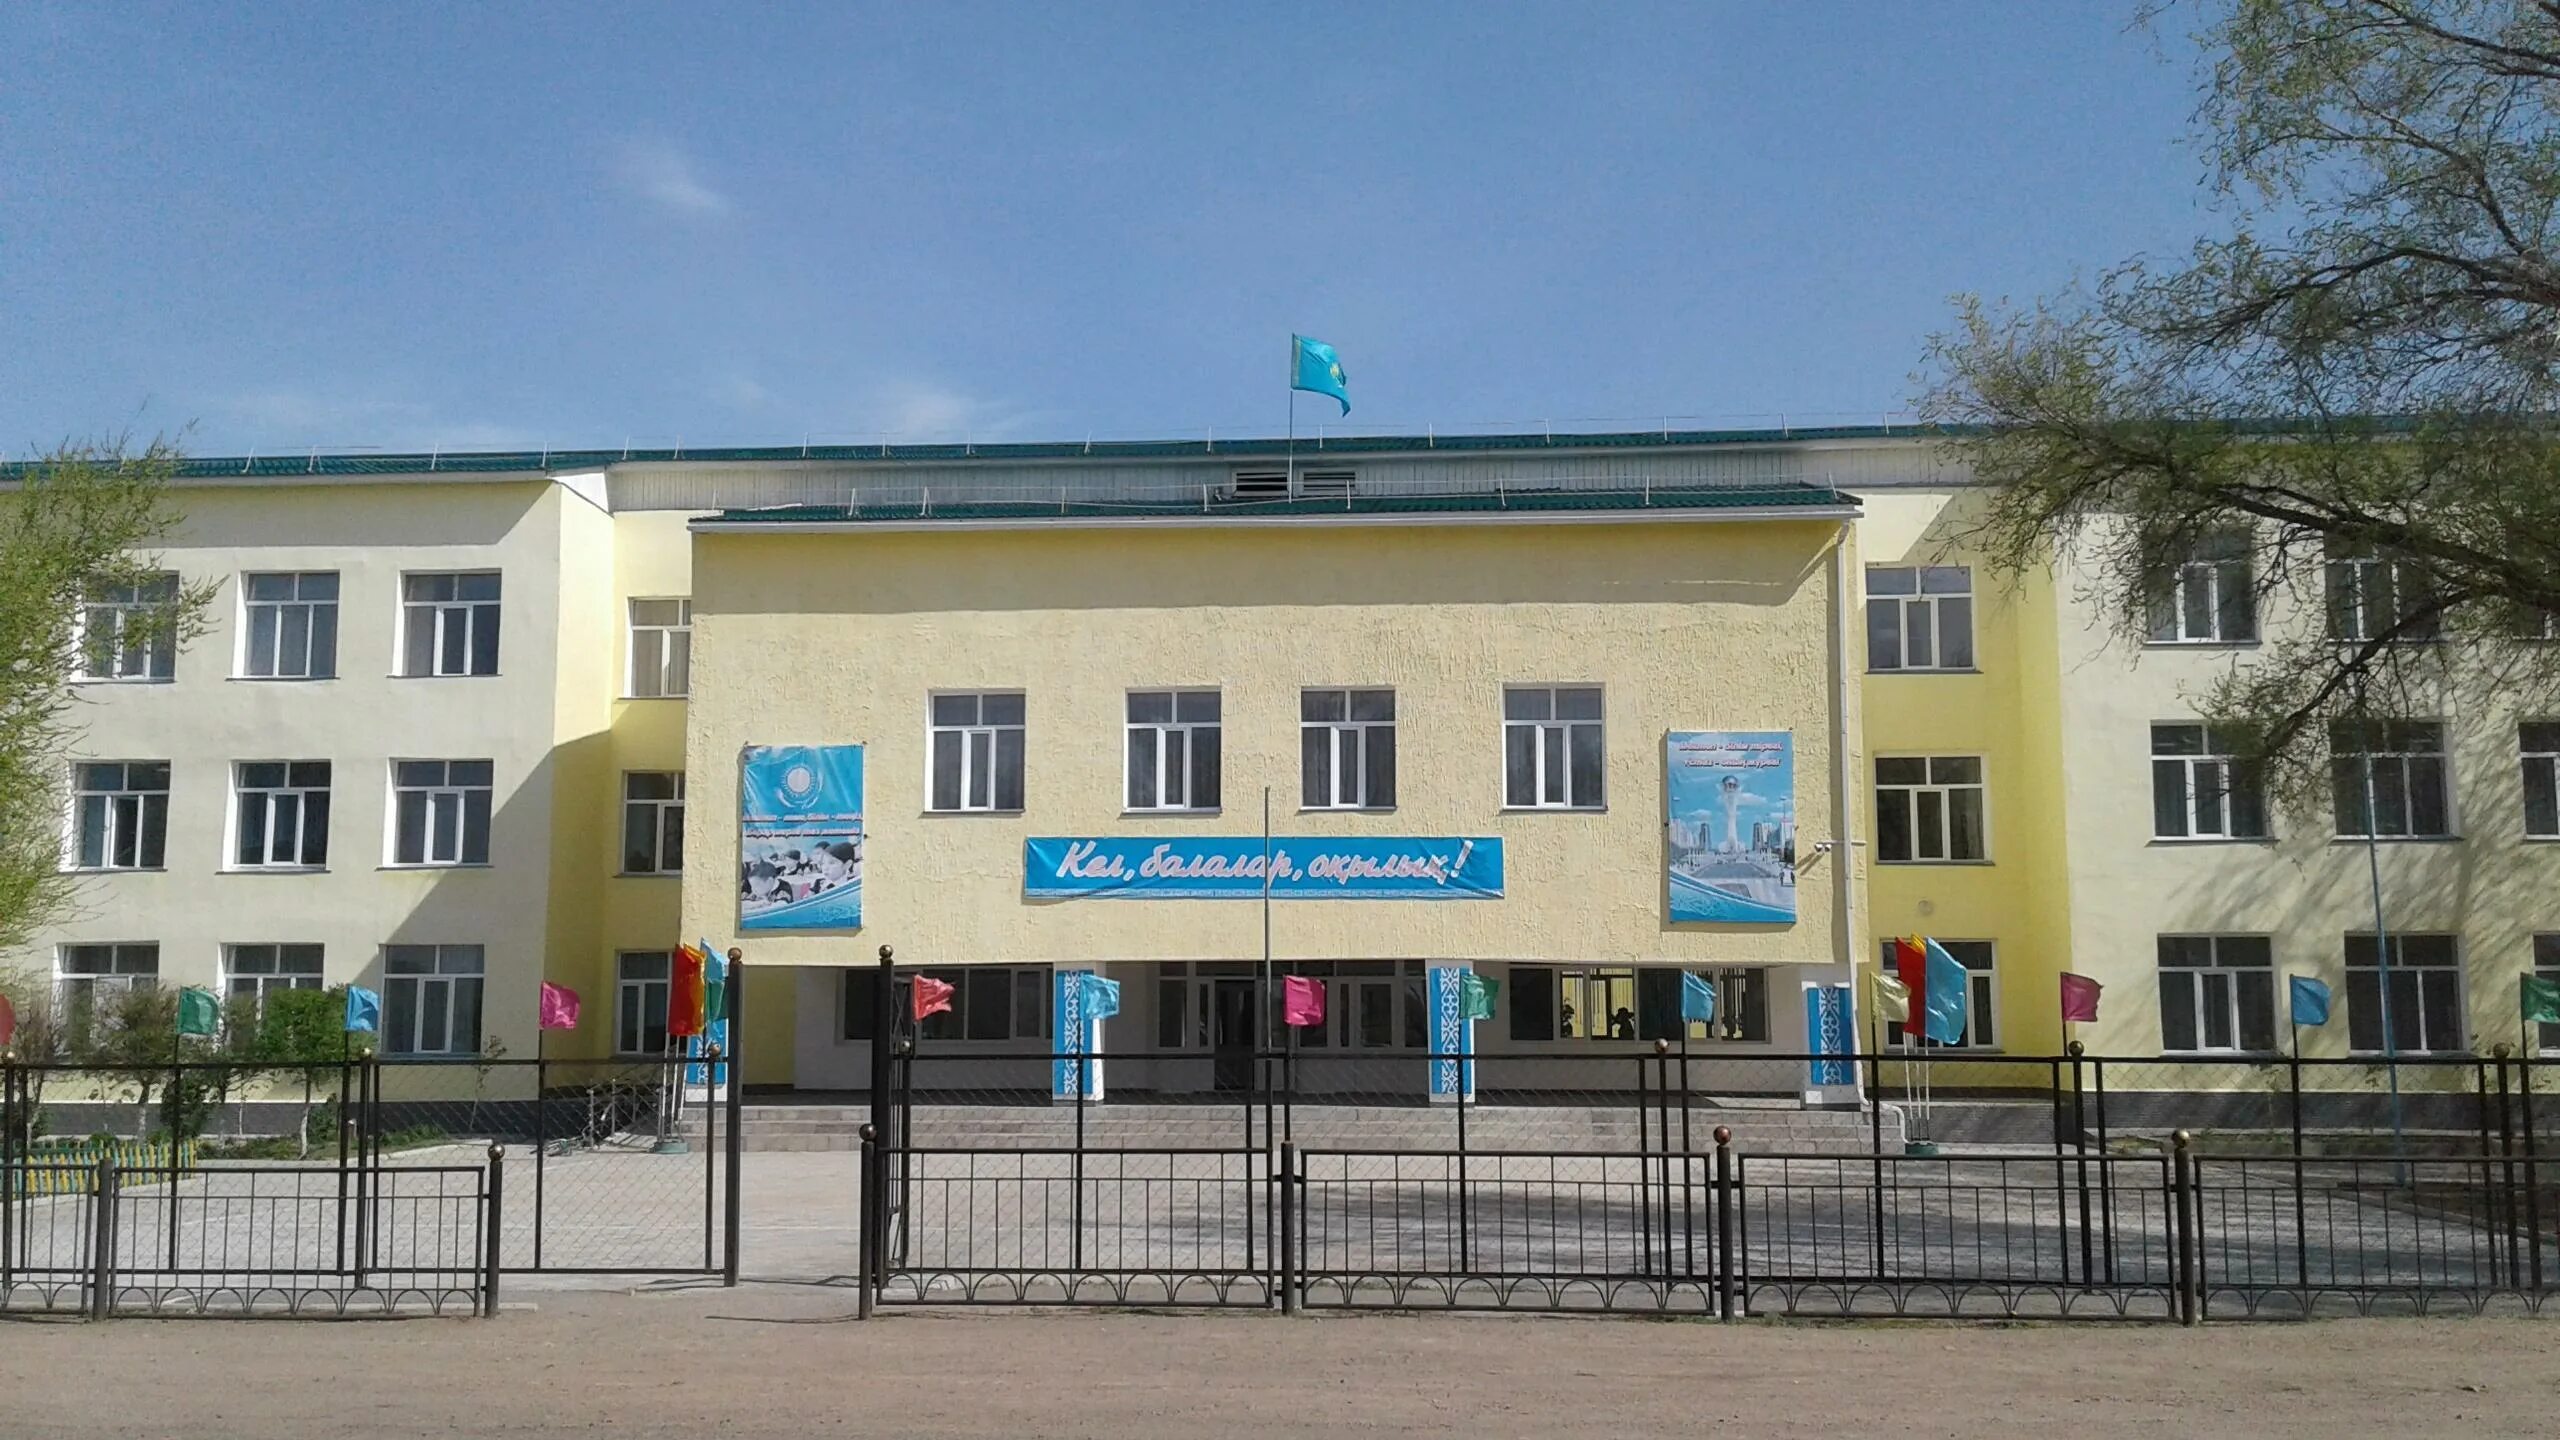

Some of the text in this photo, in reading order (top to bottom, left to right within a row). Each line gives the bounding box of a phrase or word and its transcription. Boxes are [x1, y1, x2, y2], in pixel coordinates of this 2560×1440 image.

[1055, 839, 1474, 889] Кел, балалар, оқылық!
